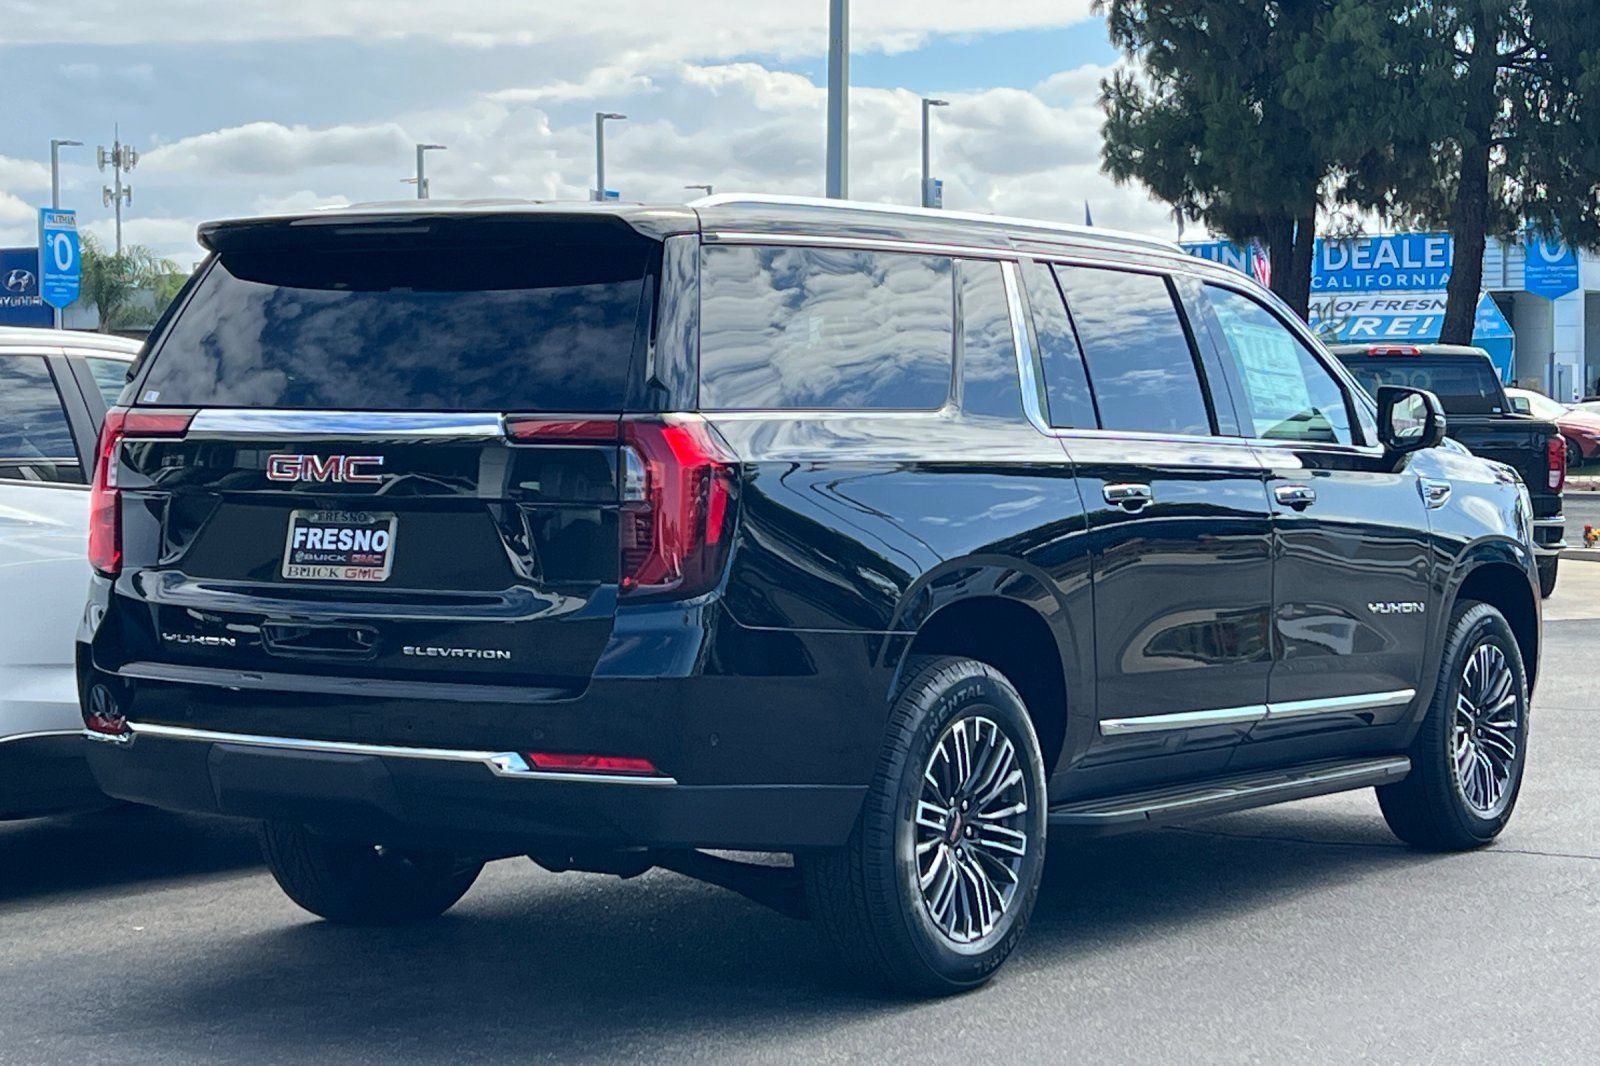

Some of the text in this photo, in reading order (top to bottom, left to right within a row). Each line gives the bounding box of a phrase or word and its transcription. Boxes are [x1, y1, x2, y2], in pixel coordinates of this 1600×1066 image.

[1322, 238, 1454, 271] DEALE
[1311, 273, 1450, 289] CALIFORNIA
[1335, 301, 1369, 312] OF
[1370, 299, 1448, 311] FRESN
[266, 454, 384, 484] GMC
[319, 511, 367, 522] FRESNO
[293, 527, 390, 552] FRESNO
[304, 552, 383, 564] BUICK GMC
[286, 566, 384, 579] BUICK GMC
[1367, 602, 1425, 613] YUKON
[162, 633, 236, 647] YUKON
[403, 646, 511, 659] ELEVATION
